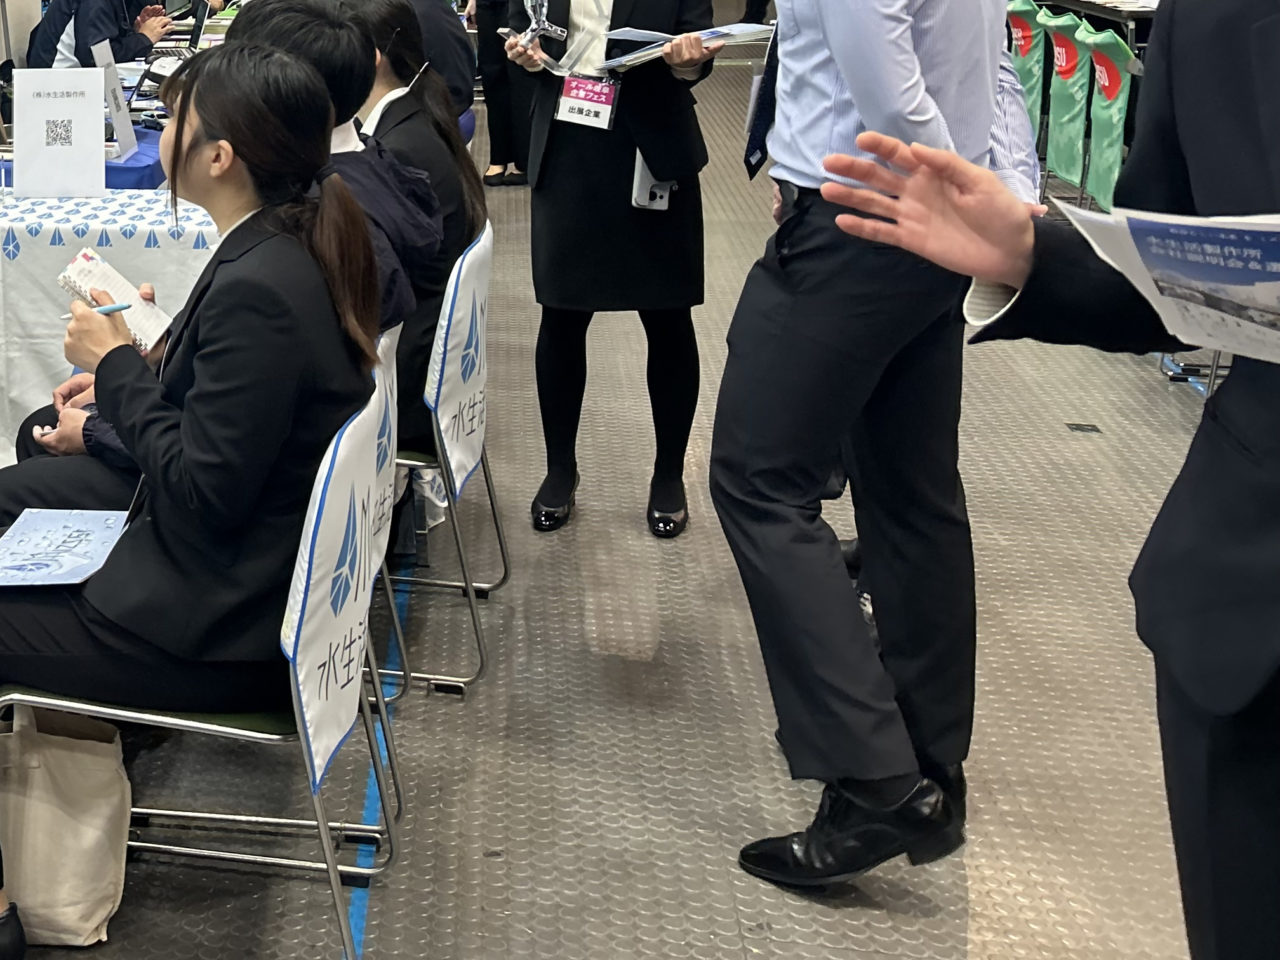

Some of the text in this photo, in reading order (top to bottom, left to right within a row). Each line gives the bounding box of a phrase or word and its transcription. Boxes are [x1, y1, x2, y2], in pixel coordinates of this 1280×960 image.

[570, 80, 610, 94] オール岐阜
[568, 105, 601, 119] 出展企業
